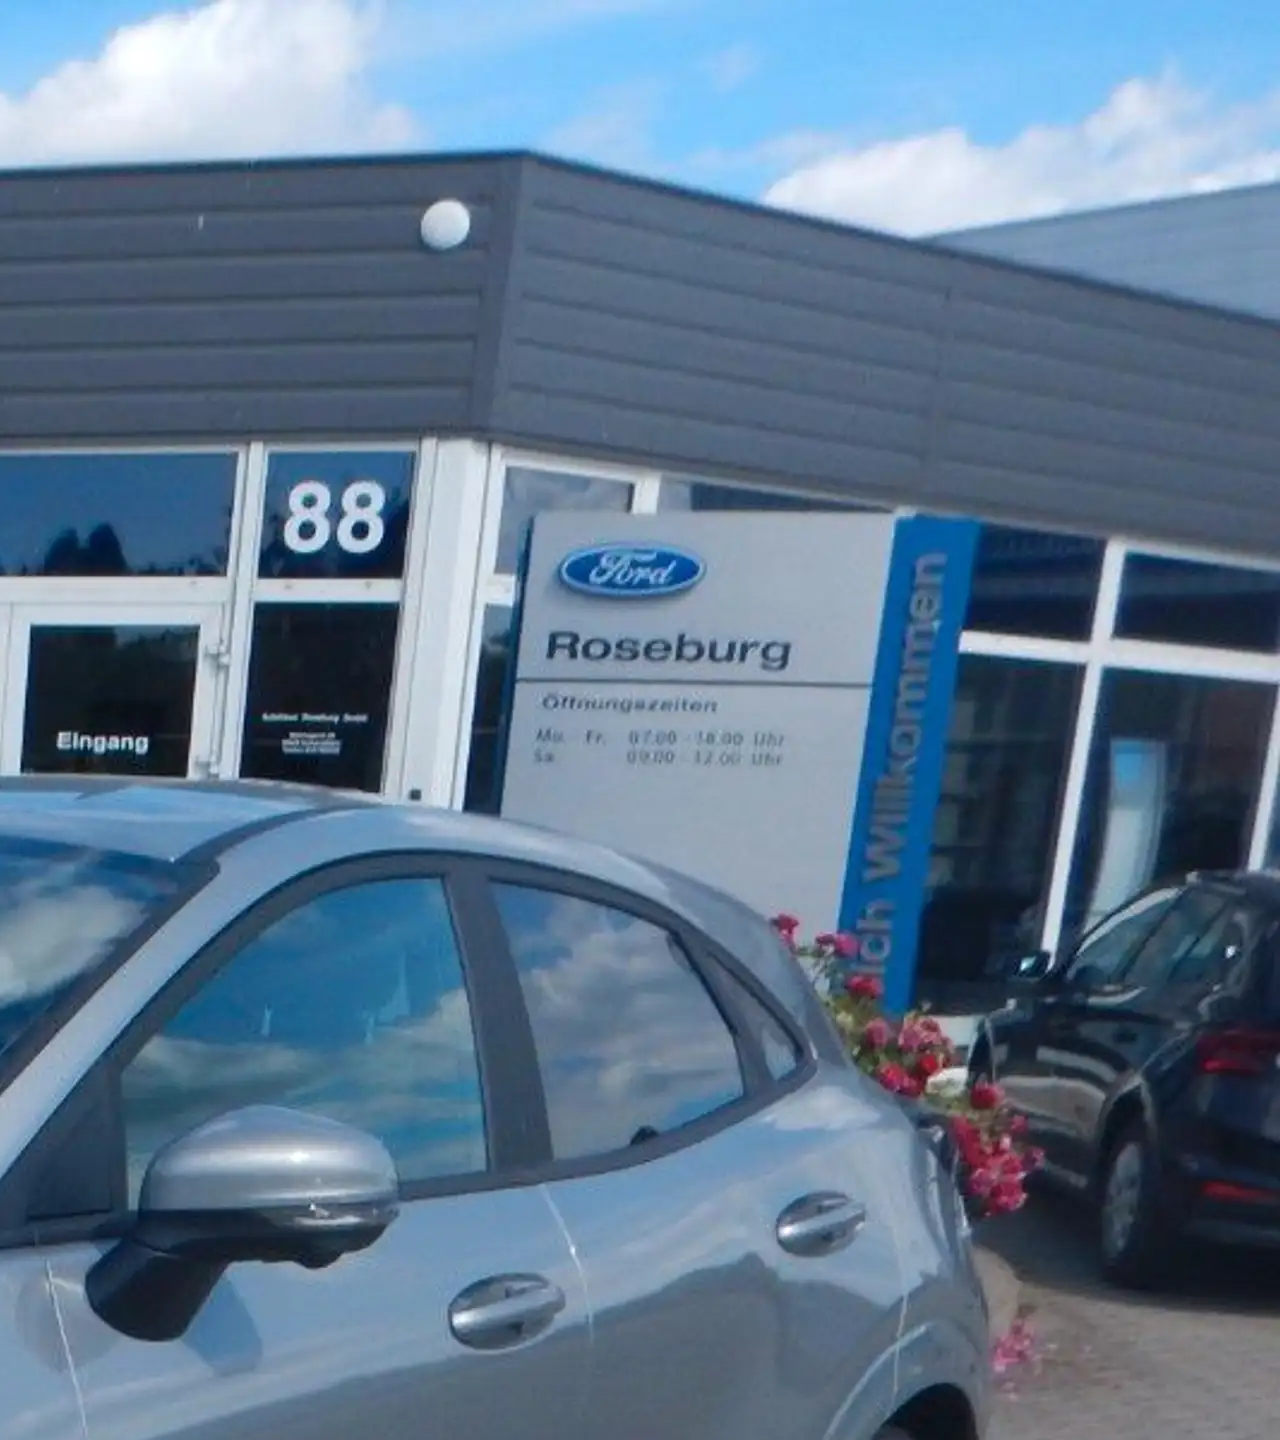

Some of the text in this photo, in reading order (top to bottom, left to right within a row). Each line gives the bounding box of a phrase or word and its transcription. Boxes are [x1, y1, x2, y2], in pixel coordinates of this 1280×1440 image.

[282, 479, 387, 555] 88
[589, 548, 676, 586] Ford
[545, 630, 793, 672] Roseburg
[863, 551, 948, 881] Willkommen
[56, 731, 149, 756] Eingang
